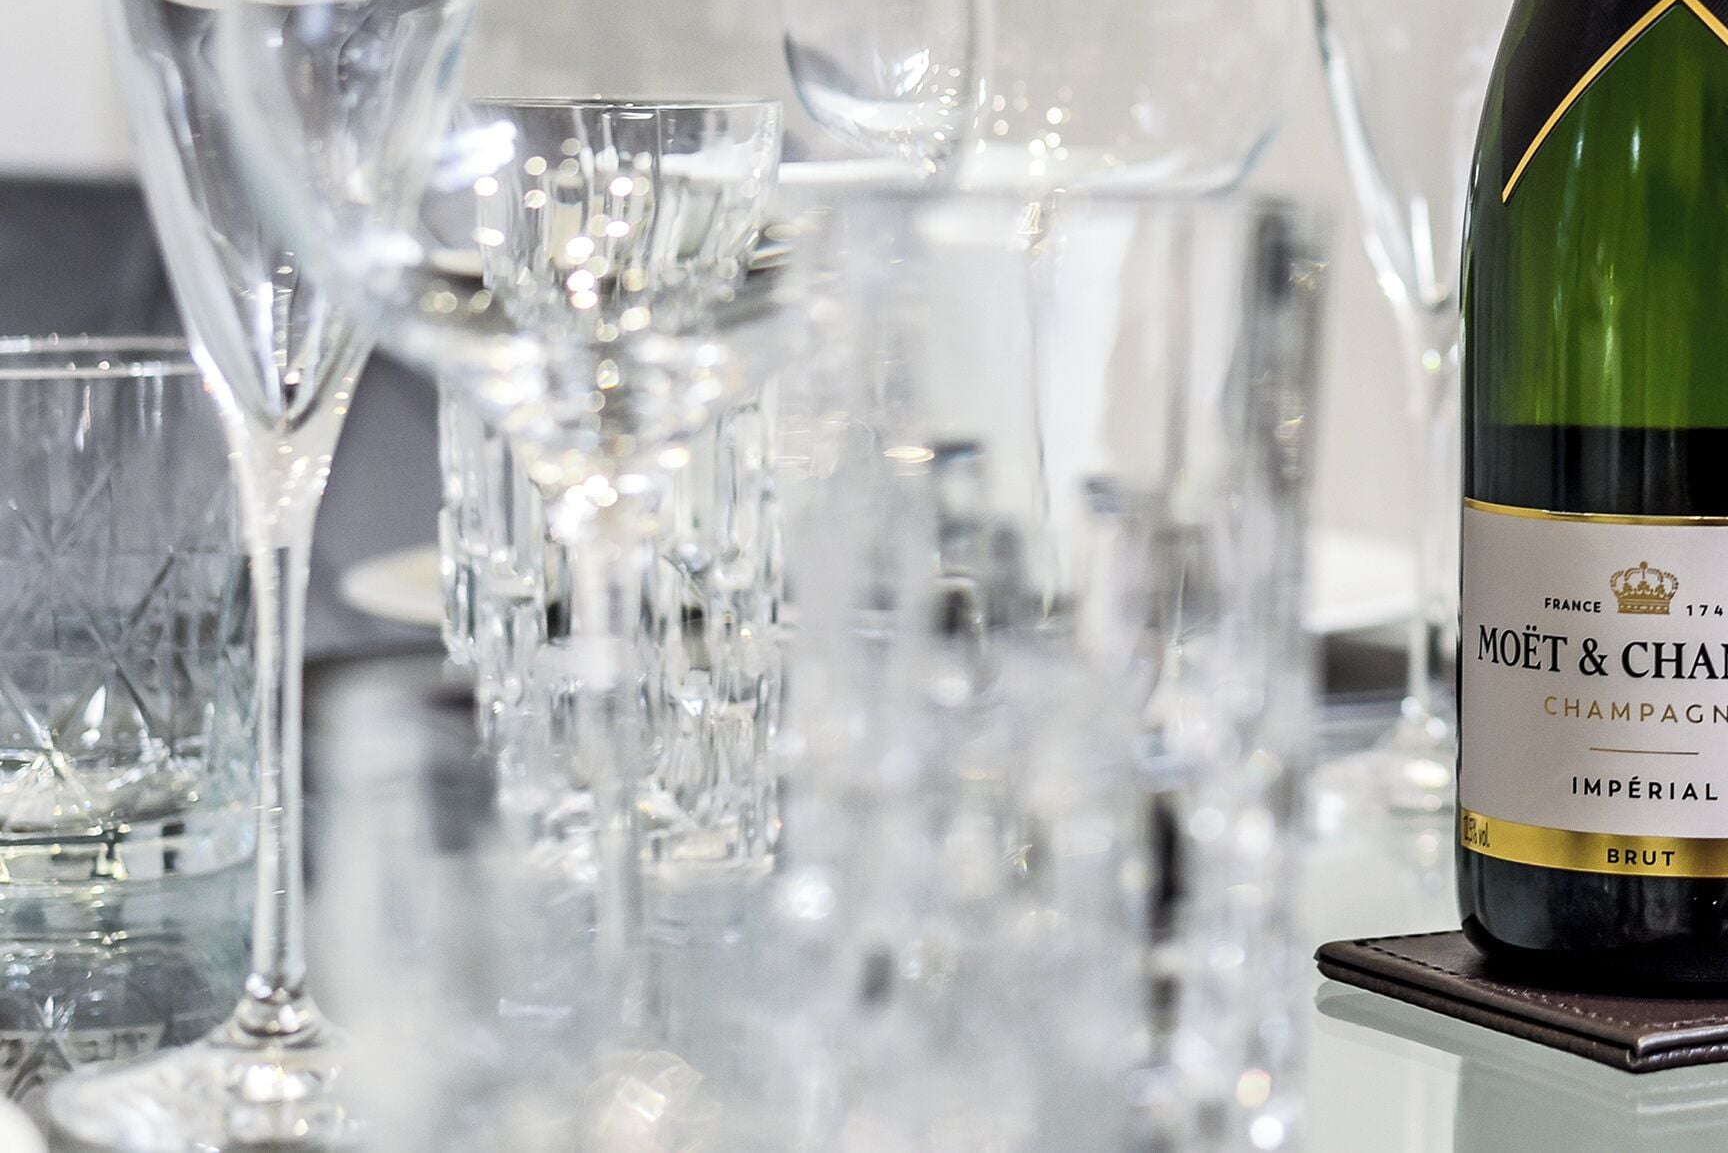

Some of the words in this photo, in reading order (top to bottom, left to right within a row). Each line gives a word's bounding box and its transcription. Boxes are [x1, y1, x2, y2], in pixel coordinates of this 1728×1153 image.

[1544, 598, 1601, 613] FRANCE
[1477, 623, 1569, 673] MOËT
[1578, 637, 1609, 677] &
[1571, 776, 1719, 801] IMPÉRIAL
[1606, 848, 1676, 867] BRUT
